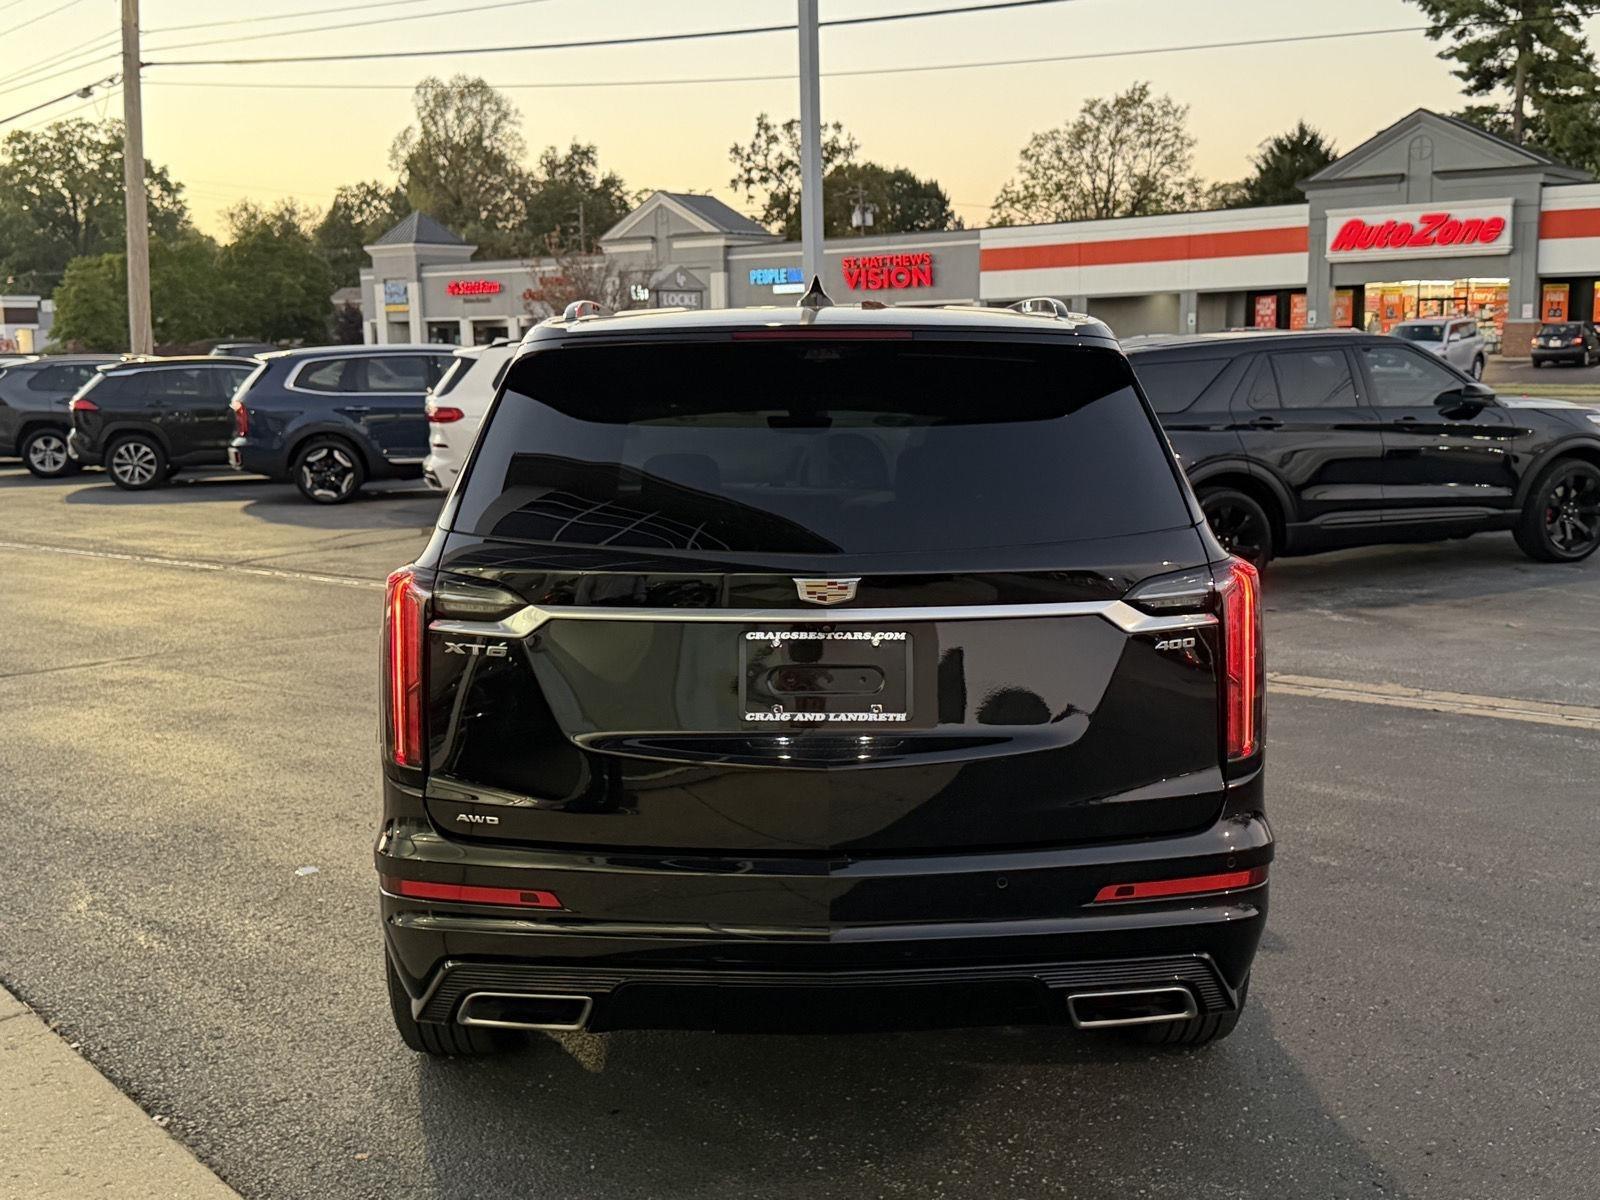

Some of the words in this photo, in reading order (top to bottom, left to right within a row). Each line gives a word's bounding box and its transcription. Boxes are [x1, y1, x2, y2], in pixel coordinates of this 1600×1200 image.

[1330, 212, 1506, 251] AutoZone
[860, 253, 932, 267] MATTHEWS
[842, 265, 933, 290] VISION
[745, 631, 906, 641] CRAIGSBESTCARS.COM
[444, 641, 508, 657] XT6
[1155, 637, 1196, 651] 400
[745, 712, 791, 722] CRAIG
[795, 712, 825, 722] AND
[828, 712, 907, 722] LANDRETH
[456, 813, 499, 825] AWD
